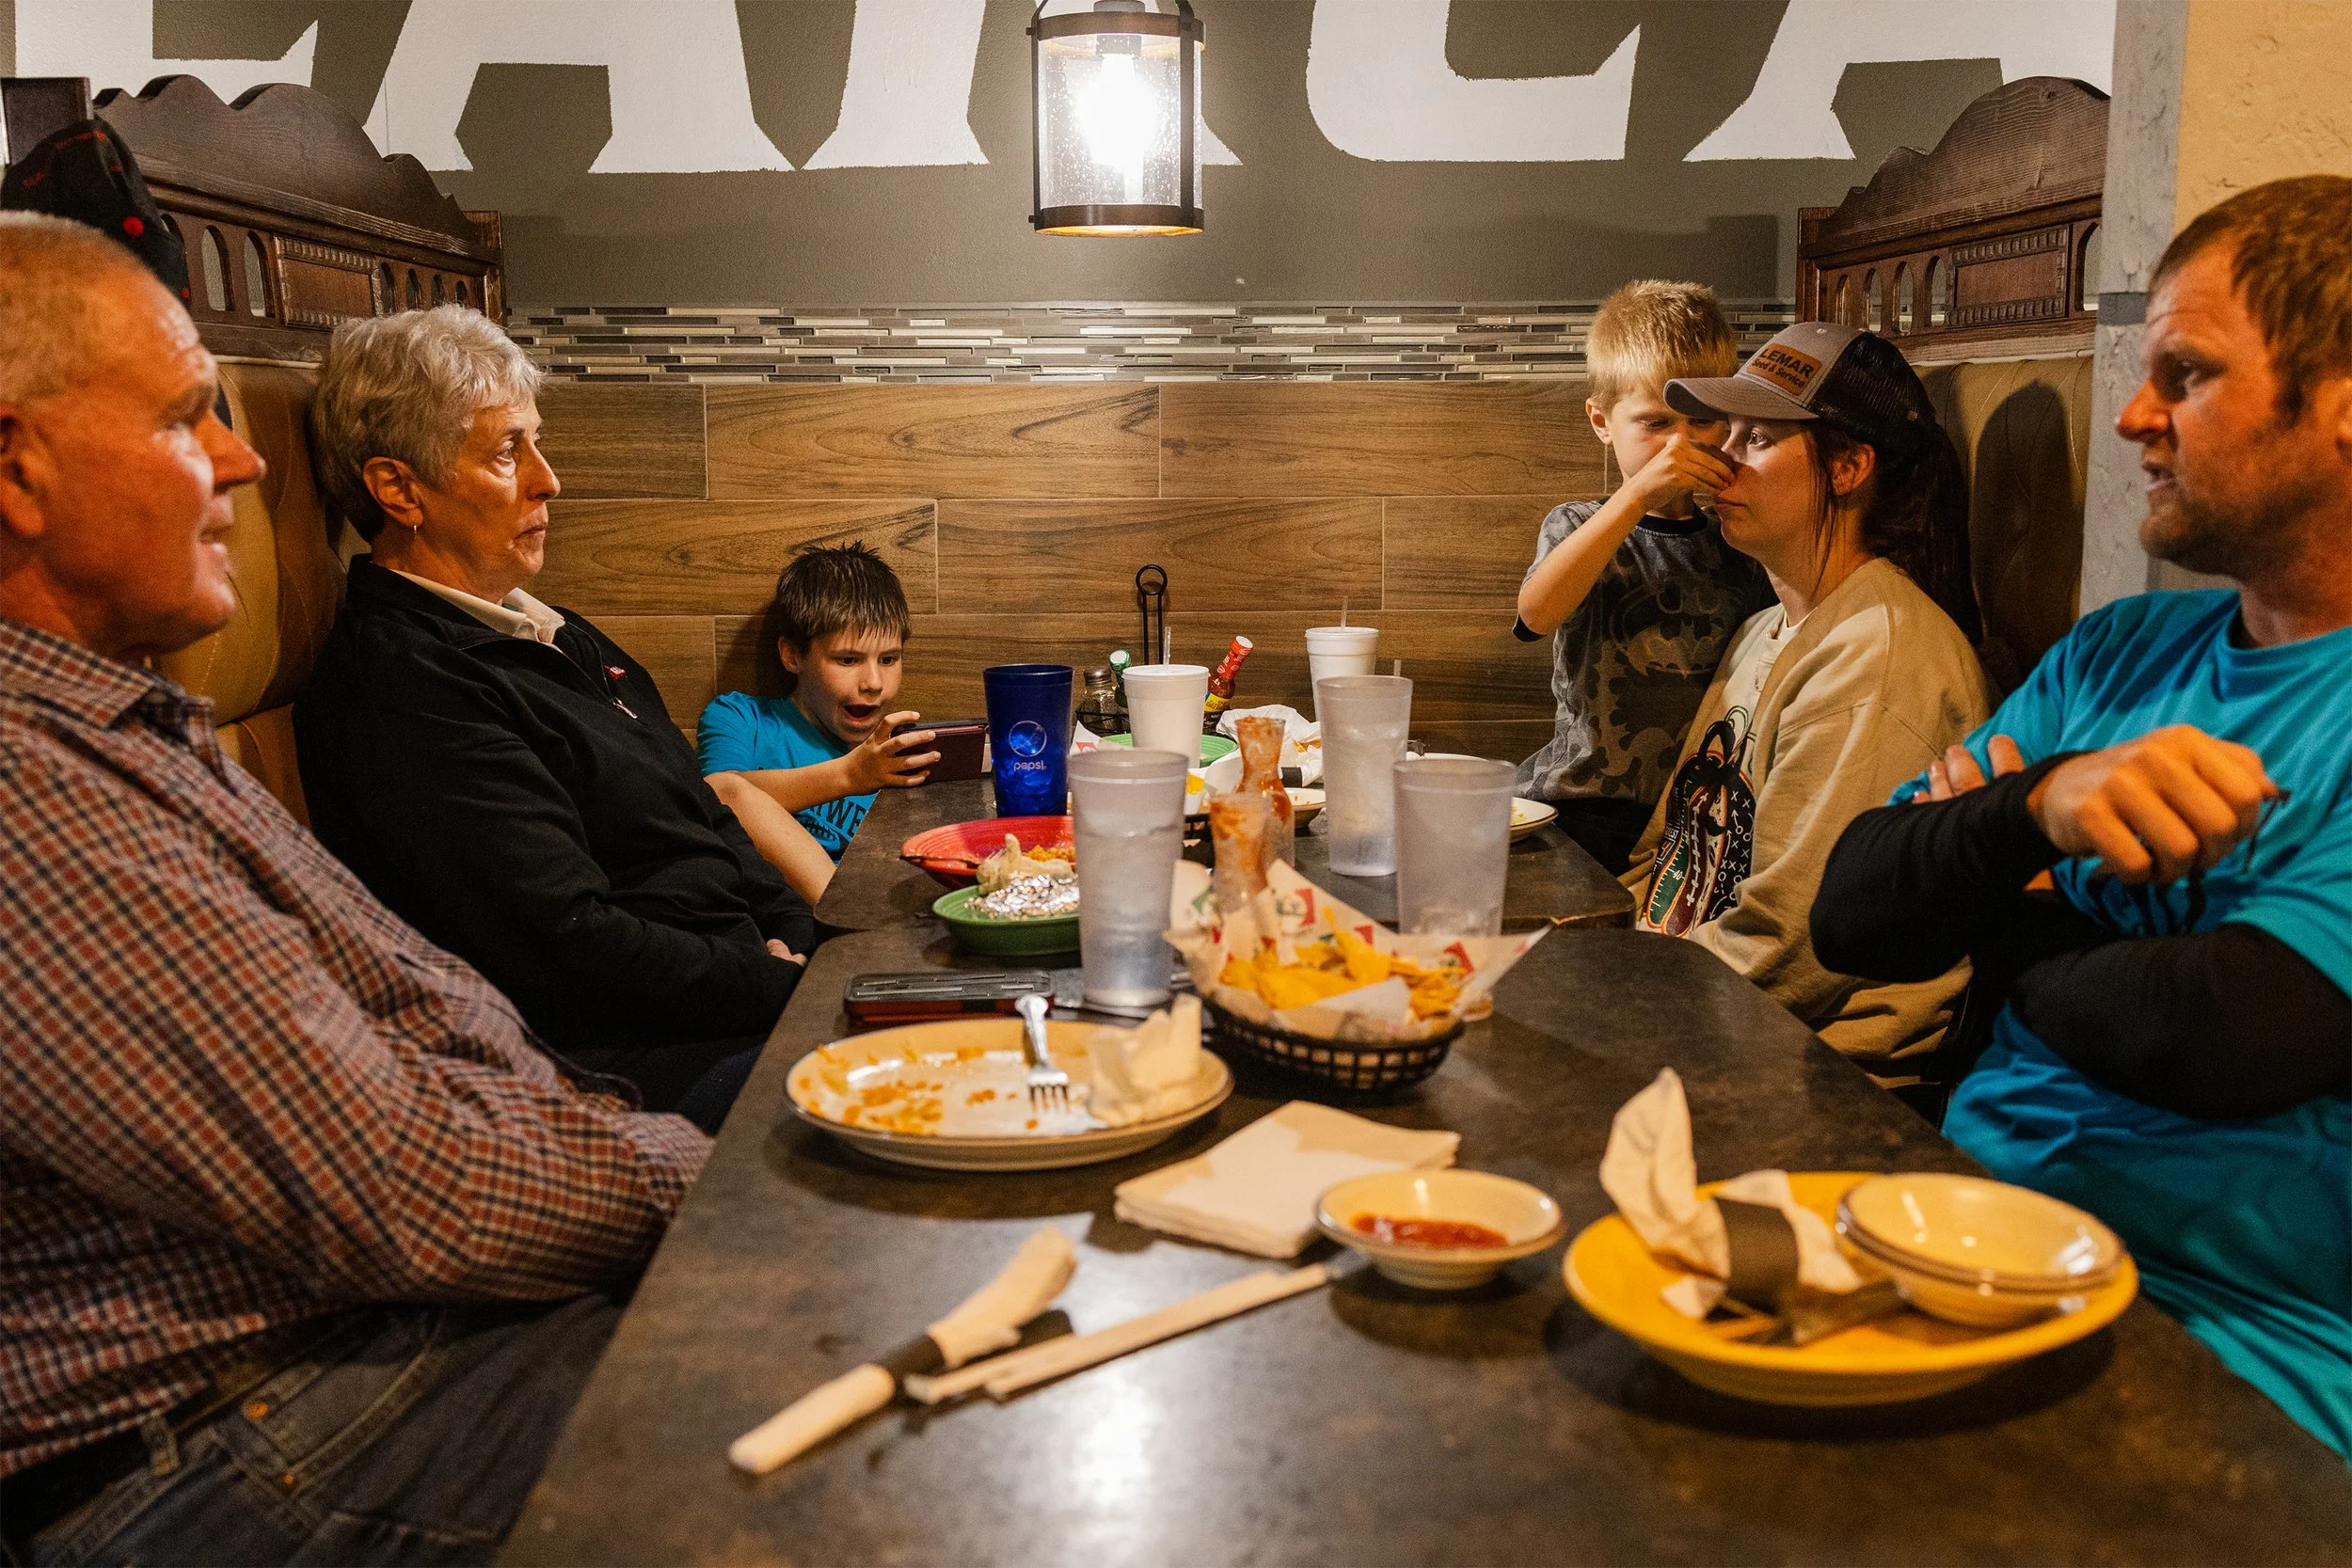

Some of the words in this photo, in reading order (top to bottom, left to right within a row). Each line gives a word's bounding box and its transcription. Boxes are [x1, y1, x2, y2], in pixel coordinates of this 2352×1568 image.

[1752, 359, 1771, 370] Seed
[1769, 364, 1777, 372] &
[1775, 367, 1805, 388] Service
[1759, 348, 1815, 379] LEMAR
[1013, 760, 1044, 771] pepsi
